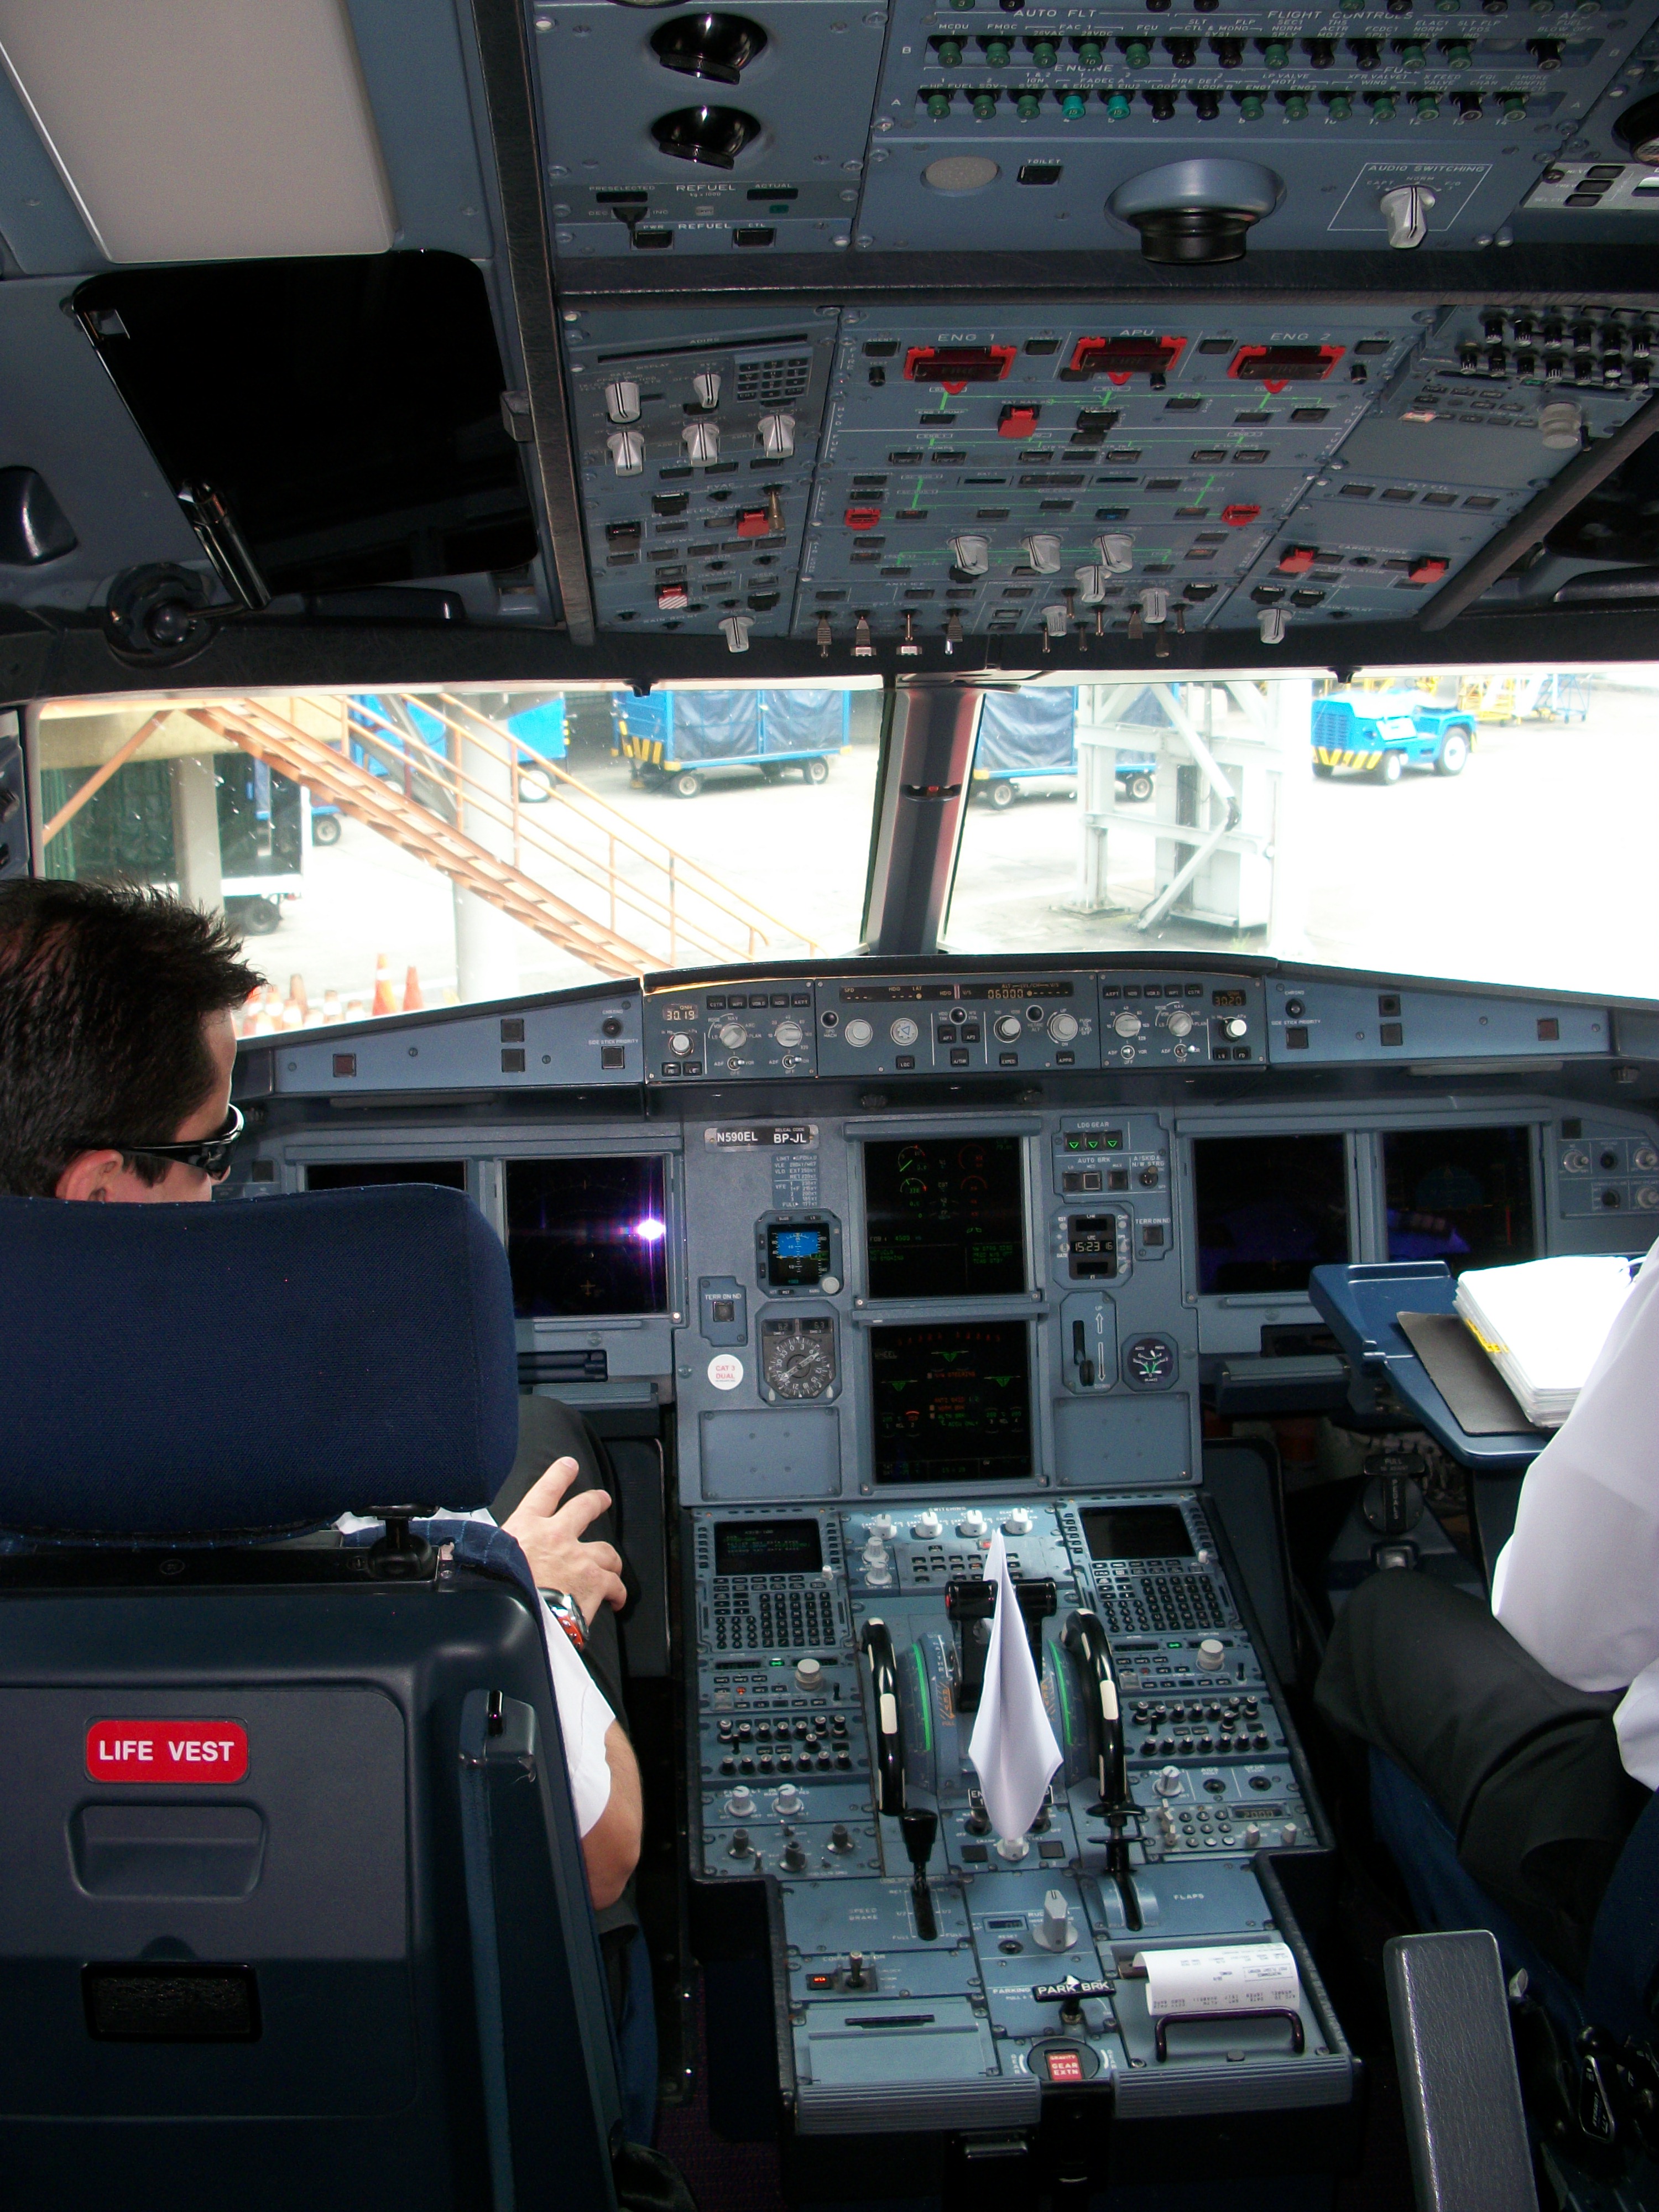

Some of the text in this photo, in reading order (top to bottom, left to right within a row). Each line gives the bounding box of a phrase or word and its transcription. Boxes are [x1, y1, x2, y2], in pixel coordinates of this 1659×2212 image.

[1268, 11, 1322, 19] FLIGHT
[988, 989, 1024, 999] 06000
[717, 1131, 758, 1142] N590EL
[774, 1133, 806, 1144] BP-JL
[98, 1740, 234, 1762] LIFE VEST
[1038, 1981, 1109, 1995] PARK BRK
